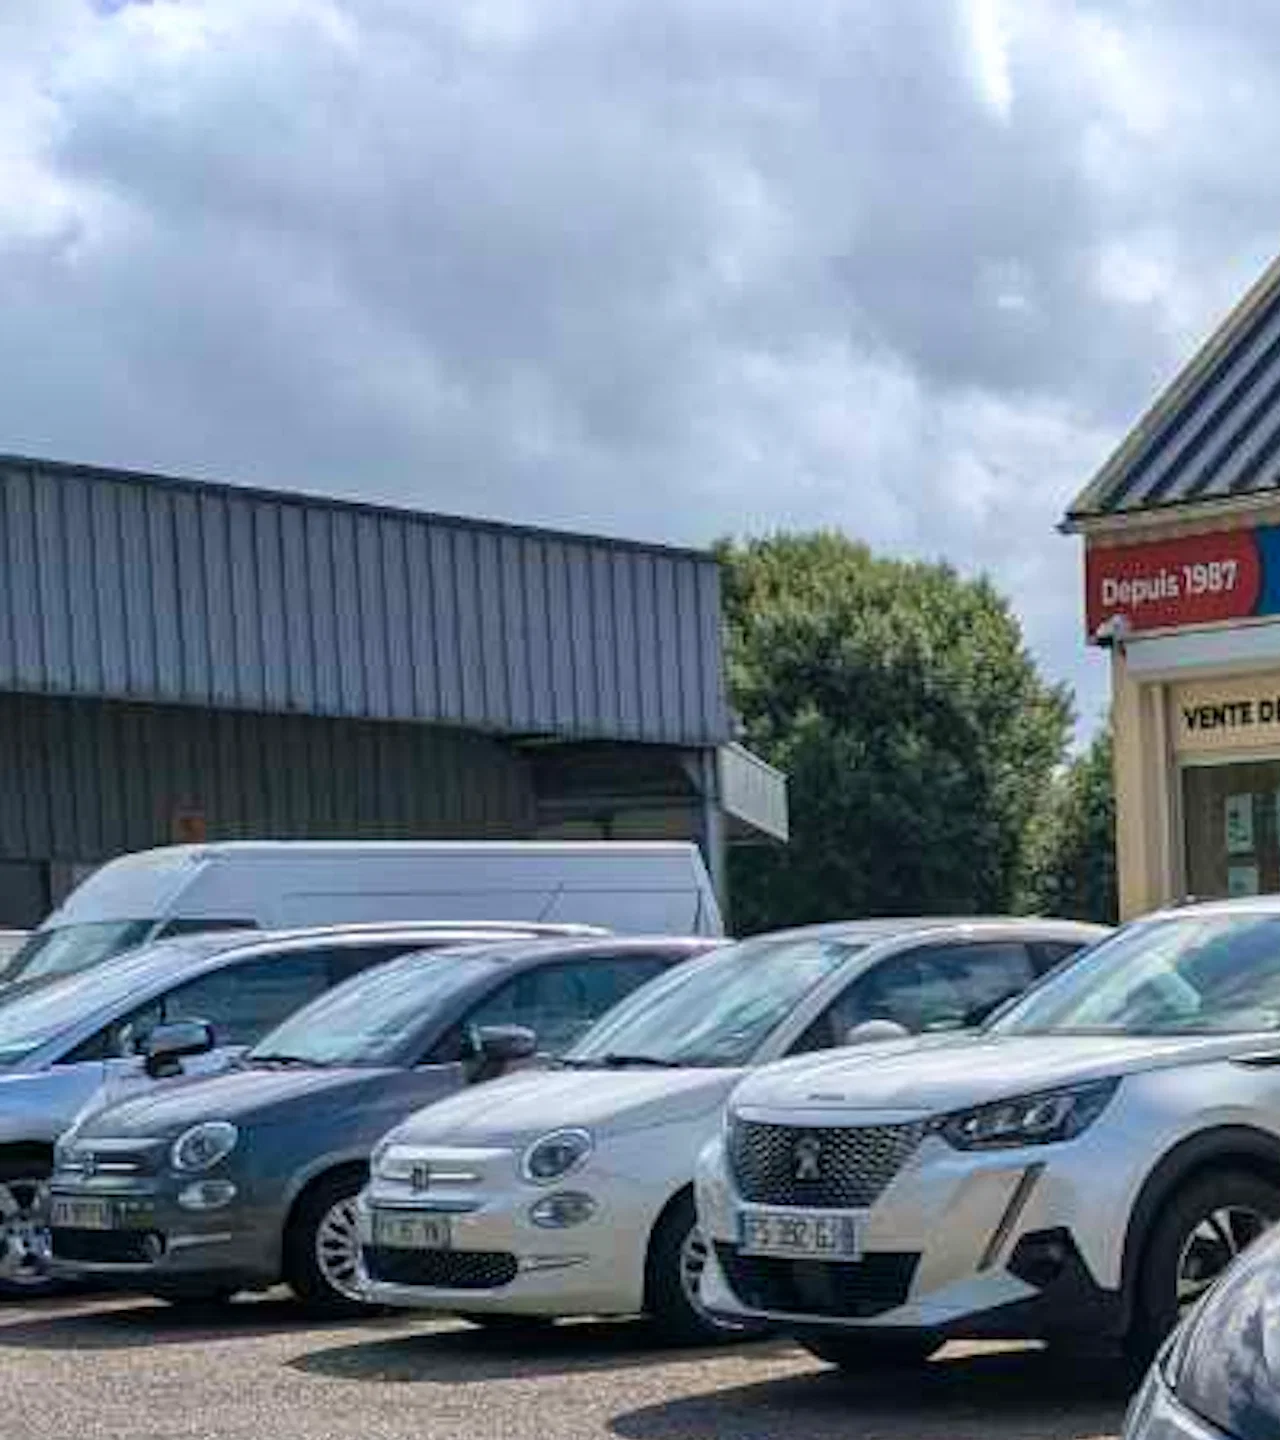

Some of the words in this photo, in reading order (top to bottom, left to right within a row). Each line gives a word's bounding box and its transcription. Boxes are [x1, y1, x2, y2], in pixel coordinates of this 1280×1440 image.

[1102, 567, 1179, 609] Depuis
[1182, 560, 1237, 594] 1987
[1183, 701, 1252, 731] VENTE
